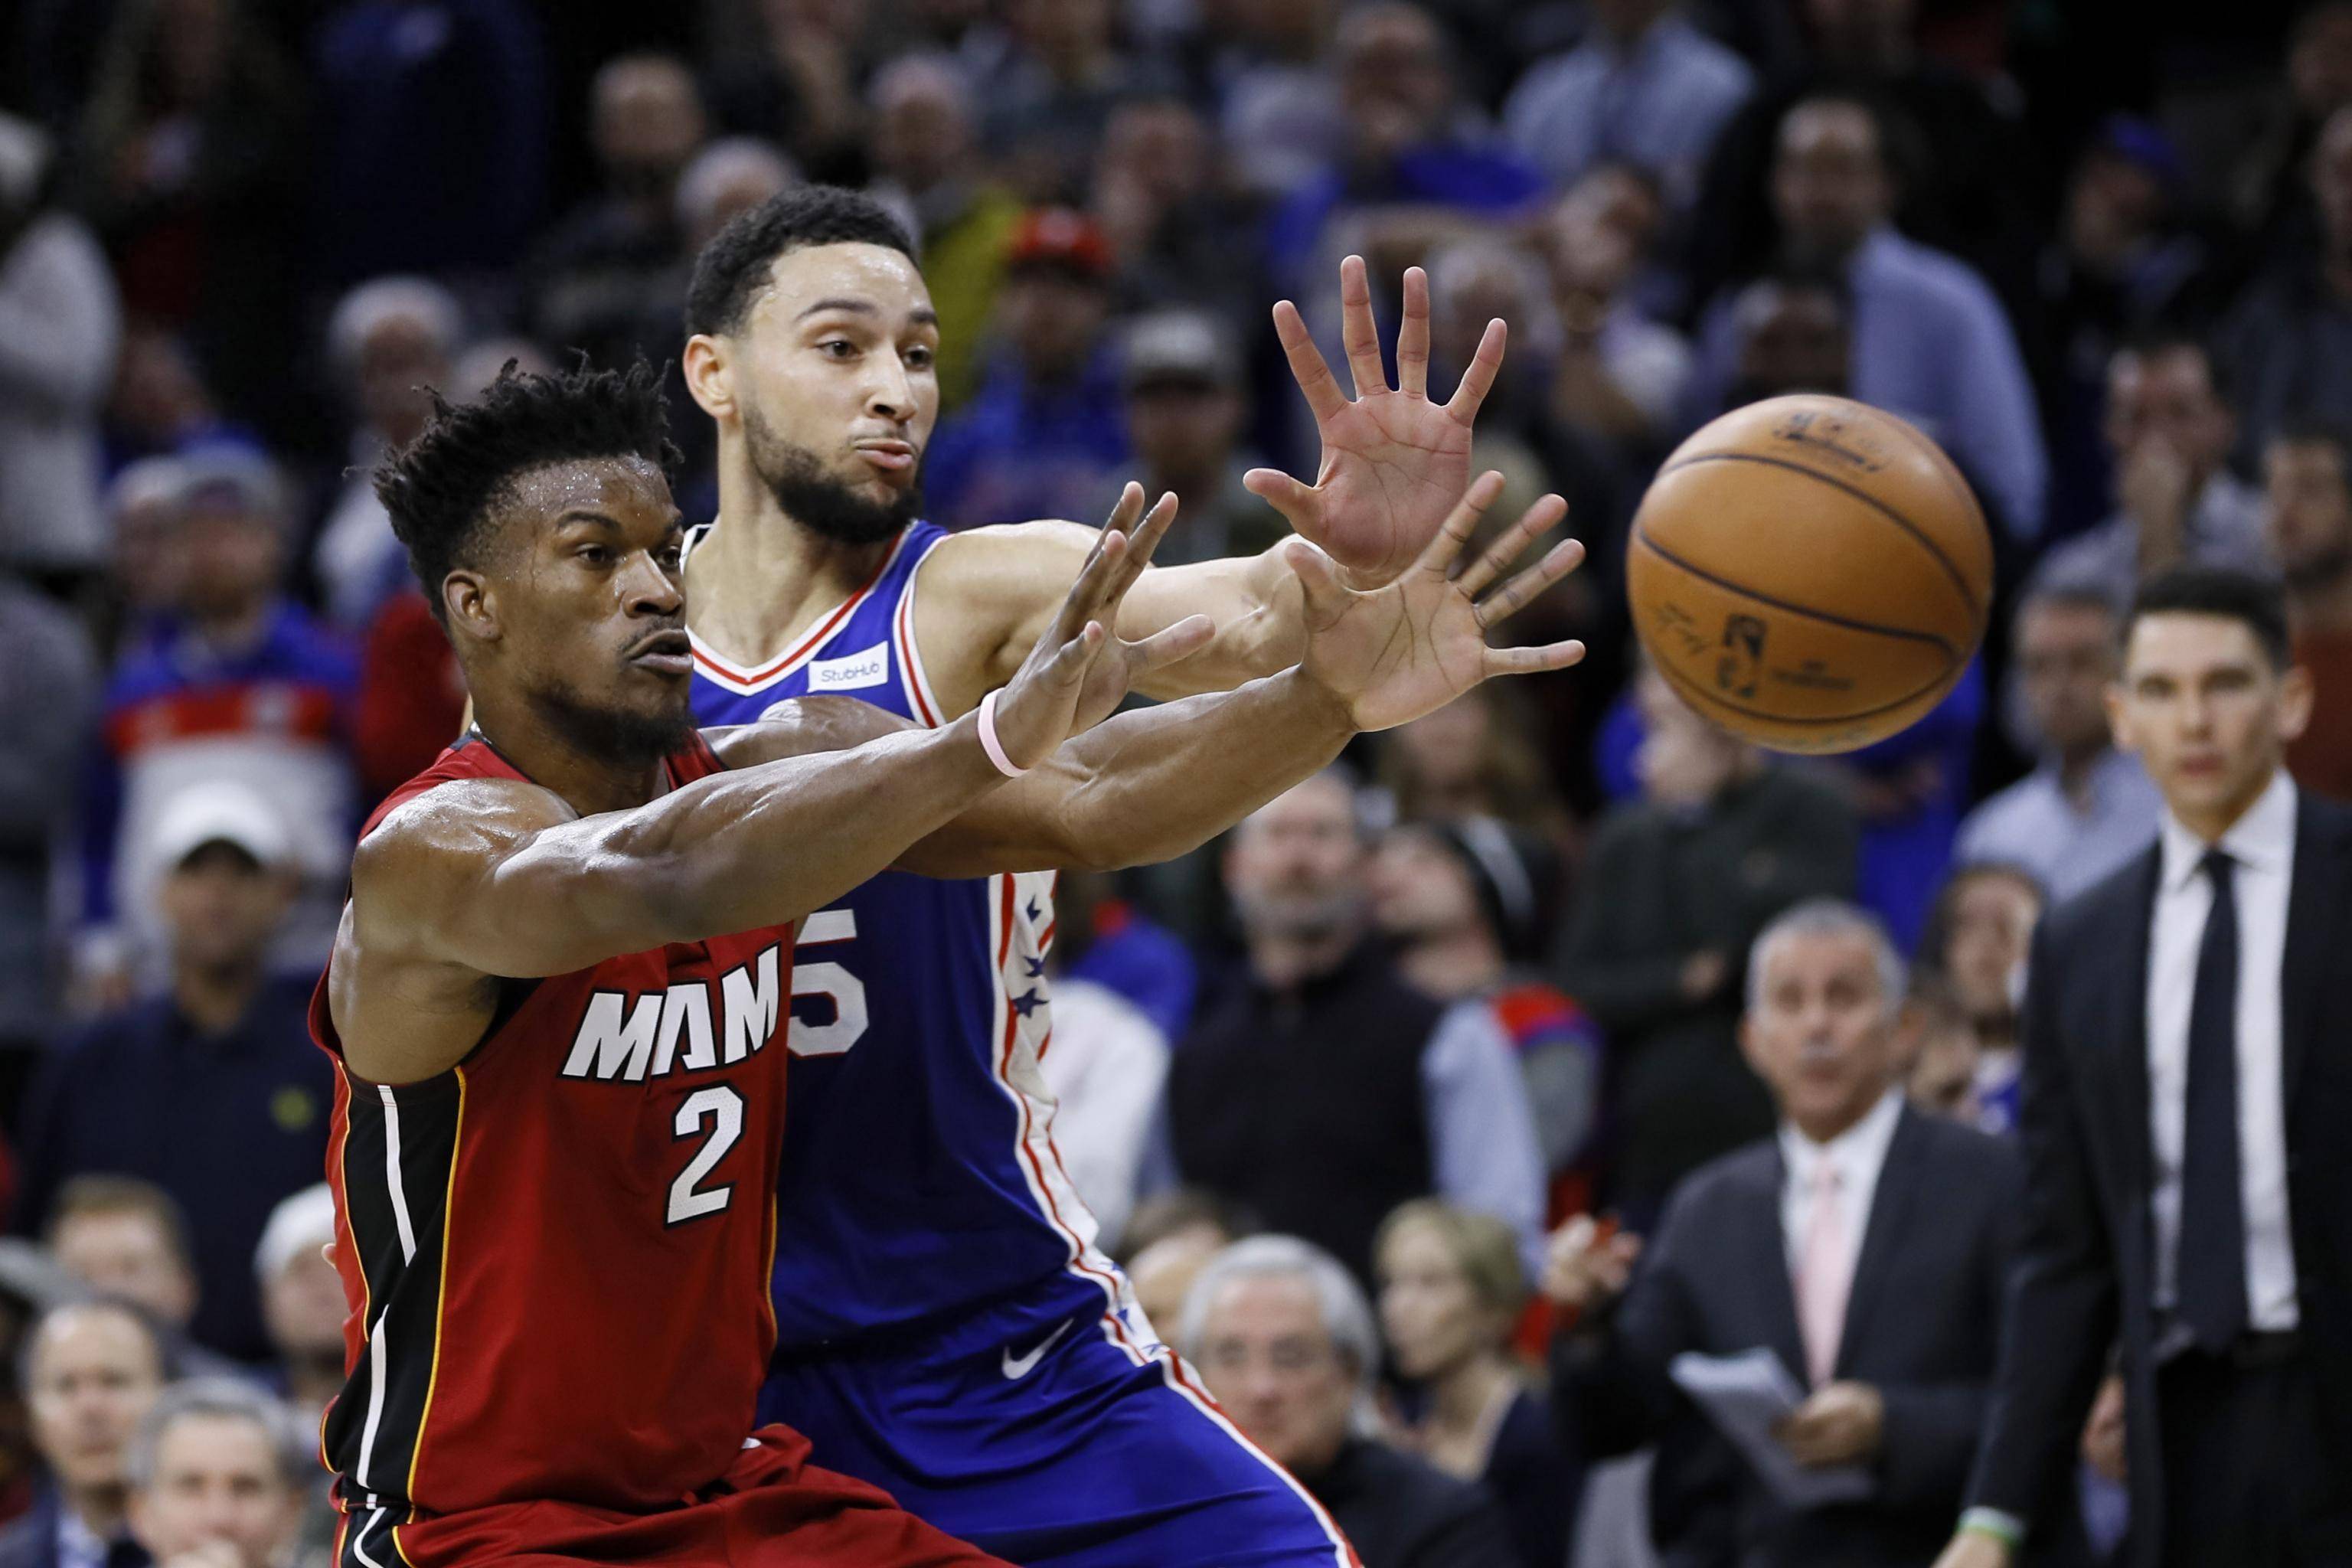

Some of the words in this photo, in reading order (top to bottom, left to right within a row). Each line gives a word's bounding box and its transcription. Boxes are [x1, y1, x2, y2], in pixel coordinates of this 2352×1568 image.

[821, 662, 880, 682] StubHub
[786, 908, 869, 1058] 5
[665, 1080, 749, 1230] 2
